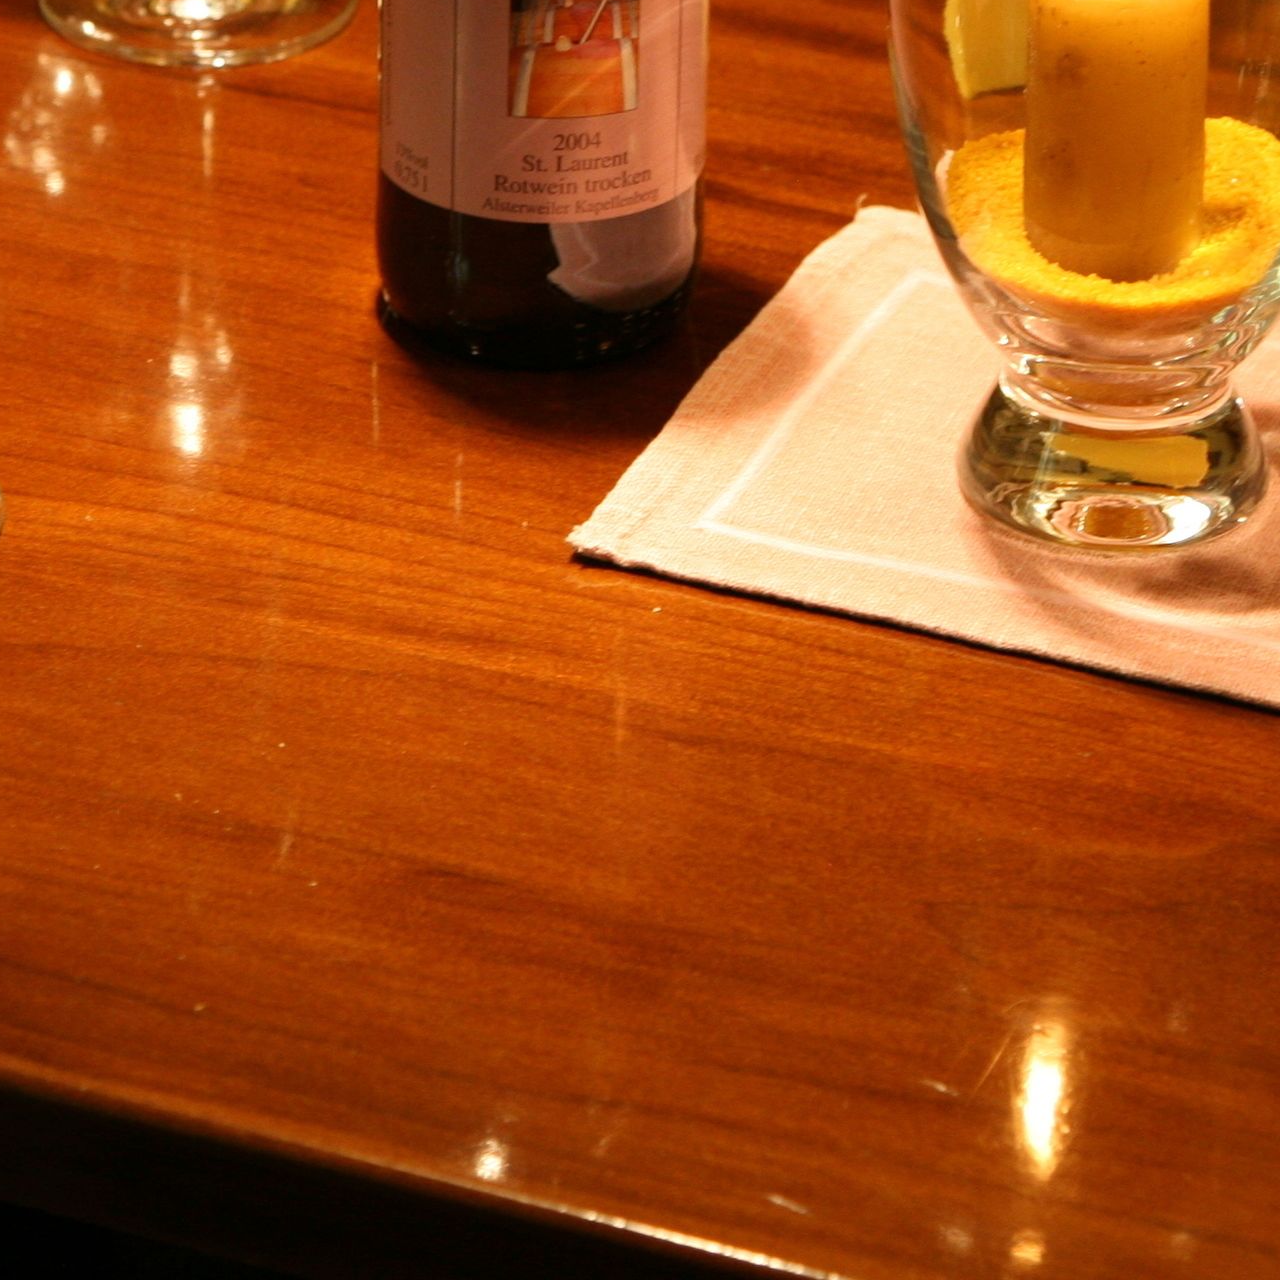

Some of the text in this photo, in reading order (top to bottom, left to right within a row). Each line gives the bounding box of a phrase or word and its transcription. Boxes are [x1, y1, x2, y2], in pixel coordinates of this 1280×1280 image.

[553, 132, 601, 151] 2004
[522, 150, 629, 172] St. Laurent
[494, 169, 652, 194] Rotwein trocken
[483, 197, 569, 214] Alsterweiler
